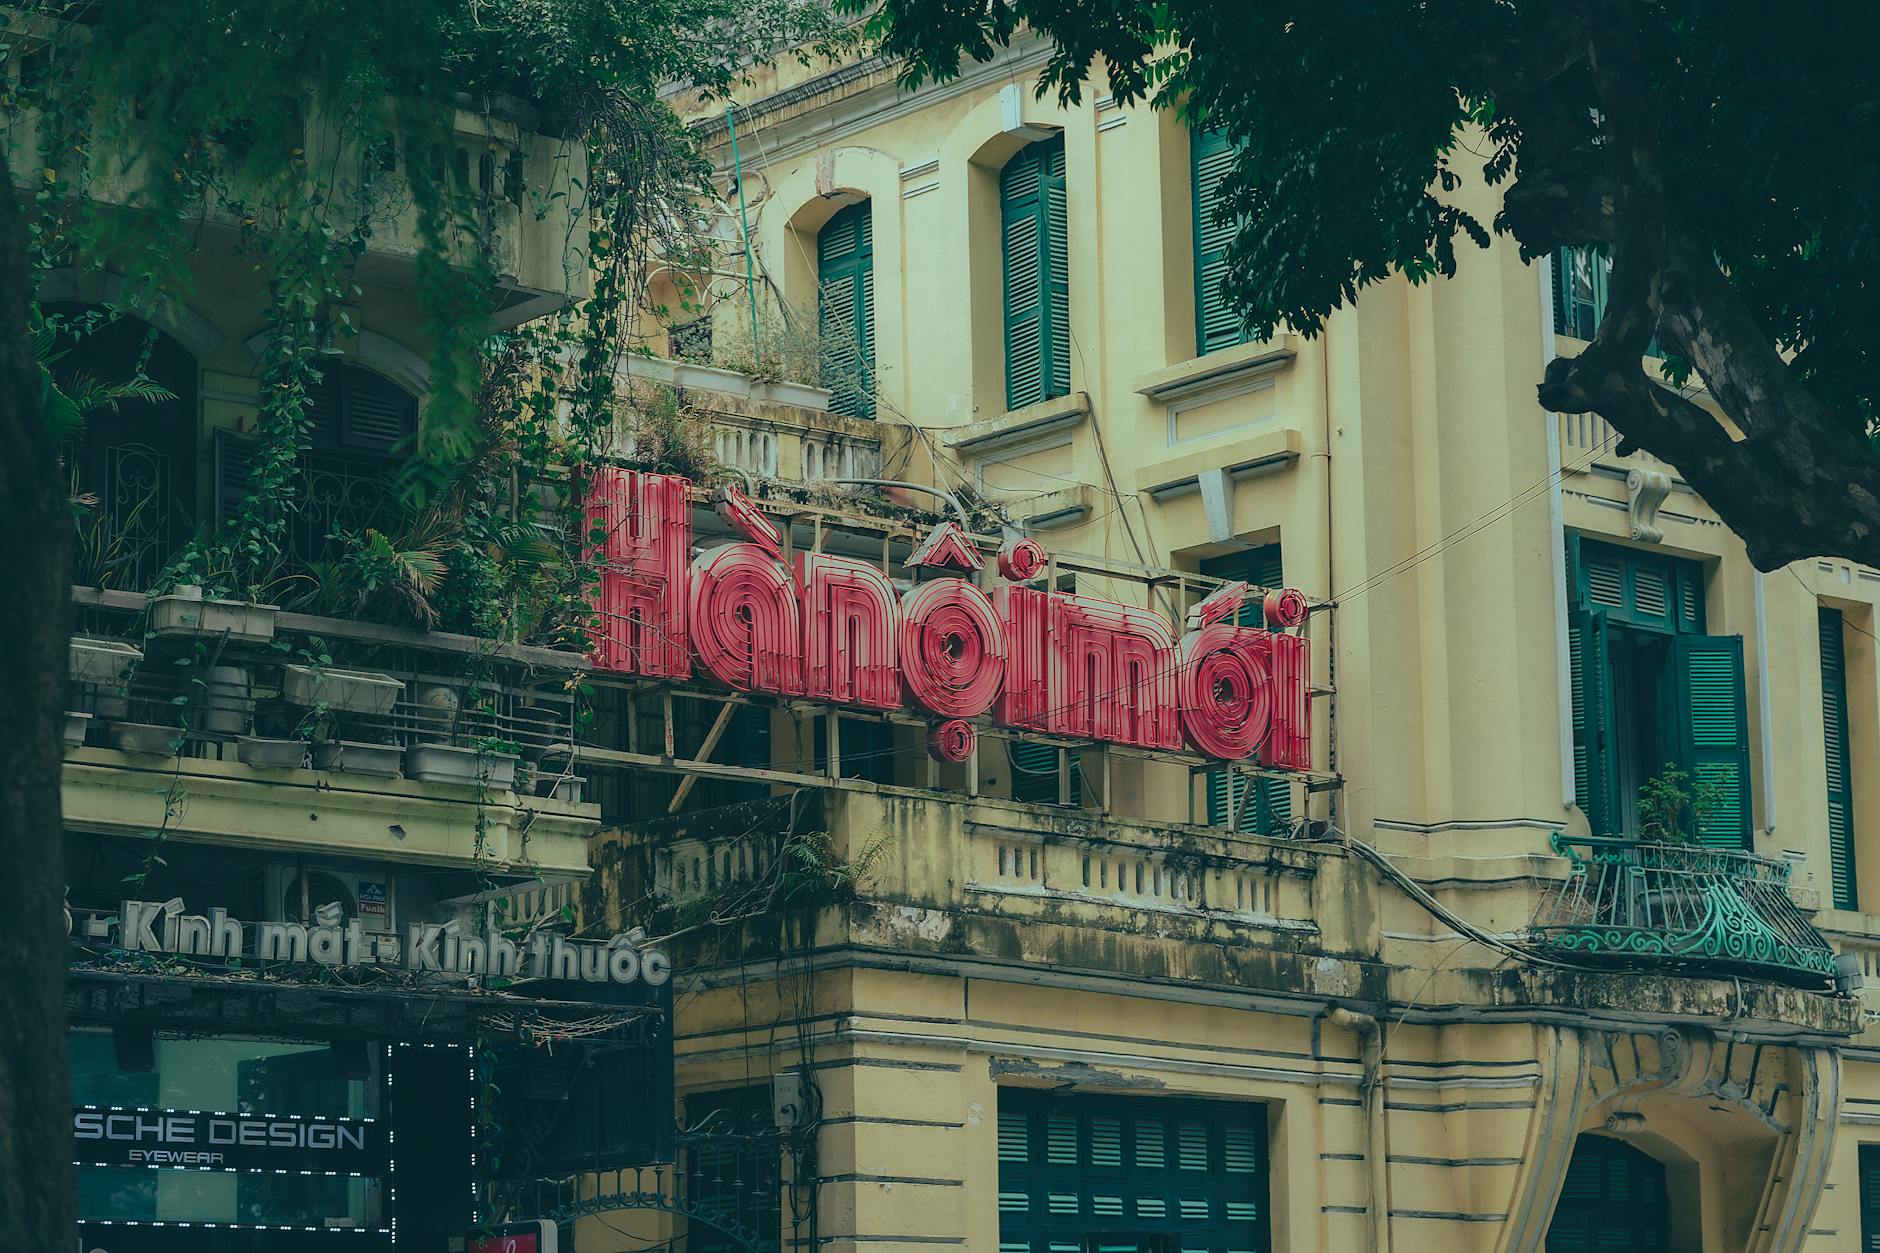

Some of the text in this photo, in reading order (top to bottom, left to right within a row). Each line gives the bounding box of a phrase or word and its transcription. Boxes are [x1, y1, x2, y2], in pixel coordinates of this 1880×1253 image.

[121, 896, 244, 958] Kính
[254, 900, 363, 966] mắt
[408, 919, 517, 976] Kính
[531, 926, 672, 987] thuốc
[74, 1113, 365, 1151] SCHE DESIGN
[129, 1149, 225, 1165] EYEWEAR
